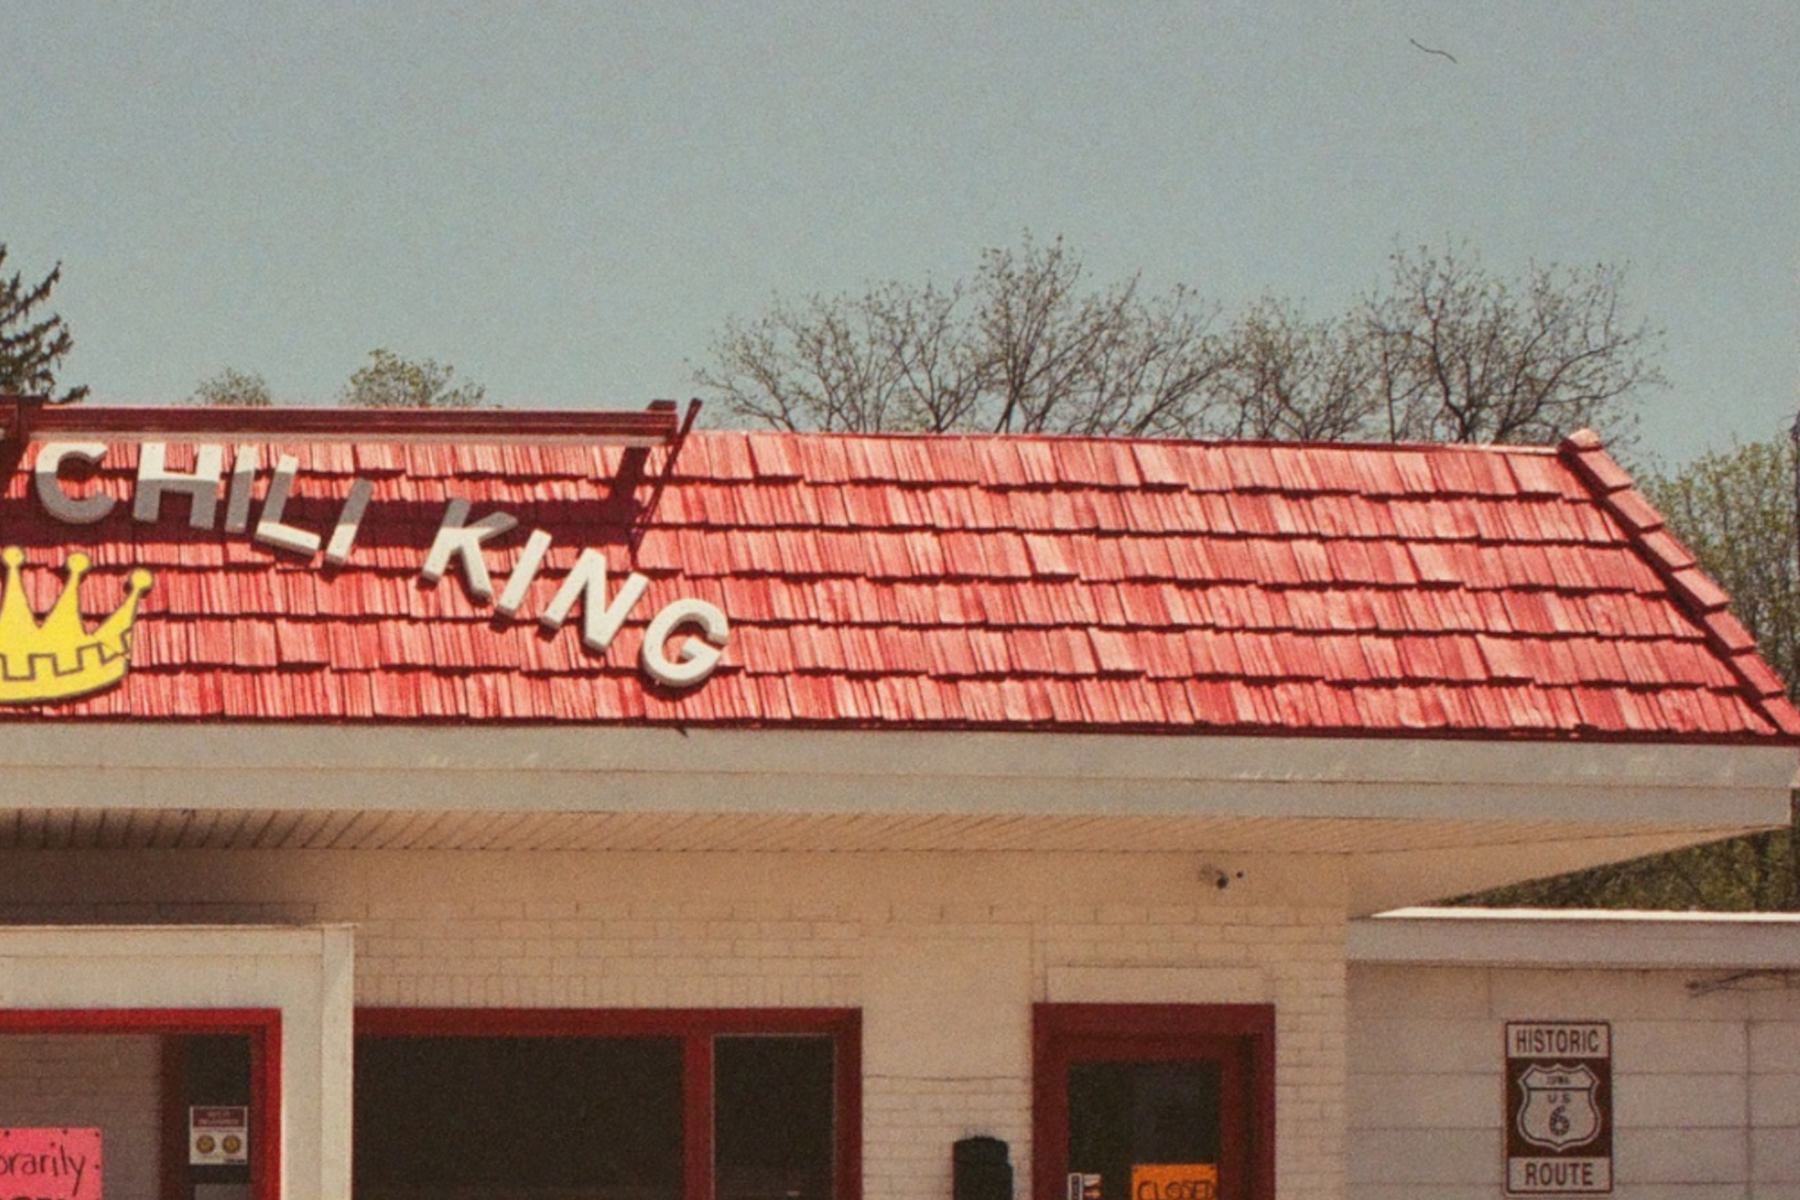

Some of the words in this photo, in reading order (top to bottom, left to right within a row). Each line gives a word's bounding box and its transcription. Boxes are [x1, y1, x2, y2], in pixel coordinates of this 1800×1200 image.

[34, 440, 375, 567] CHILI
[419, 496, 731, 689] KING
[1516, 1029, 1599, 1053] HISTORIC
[1548, 1104, 1571, 1137] 6
[1525, 1162, 1594, 1186] ROUTE
